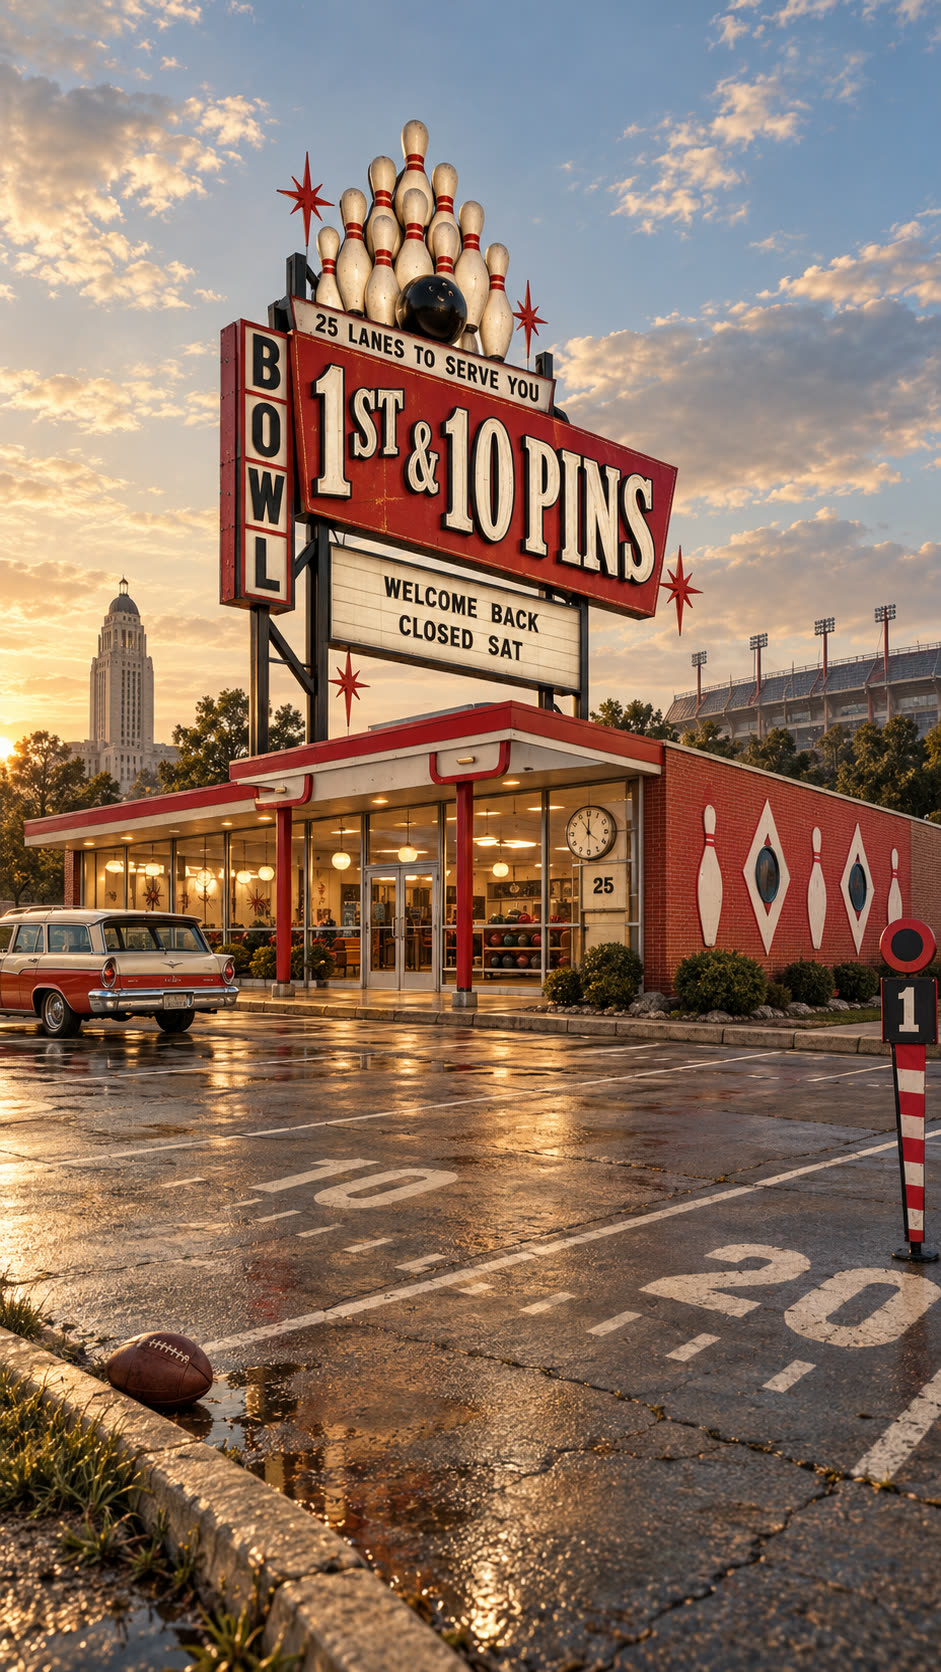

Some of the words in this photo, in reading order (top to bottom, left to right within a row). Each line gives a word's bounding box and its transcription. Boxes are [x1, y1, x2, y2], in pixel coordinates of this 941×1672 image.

[315, 313, 339, 337] 25
[348, 323, 405, 358] LANES
[414, 345, 436, 368] TO
[445, 355, 499, 390] SERVE
[507, 375, 540, 403] YOU
[248, 333, 285, 593] BOWL
[311, 363, 405, 500] 1ST
[404, 419, 440, 497] &
[441, 406, 515, 544] 10
[521, 434, 656, 586] PINS
[384, 575, 478, 619] WELCOME
[491, 602, 540, 634] BACK
[399, 614, 474, 650] CLOSED
[488, 634, 524, 661] SAT
[593, 876, 614, 894] 25
[897, 986, 920, 1033] 1
[248, 1157, 459, 1210] 10
[638, 1243, 941, 1348] 20
